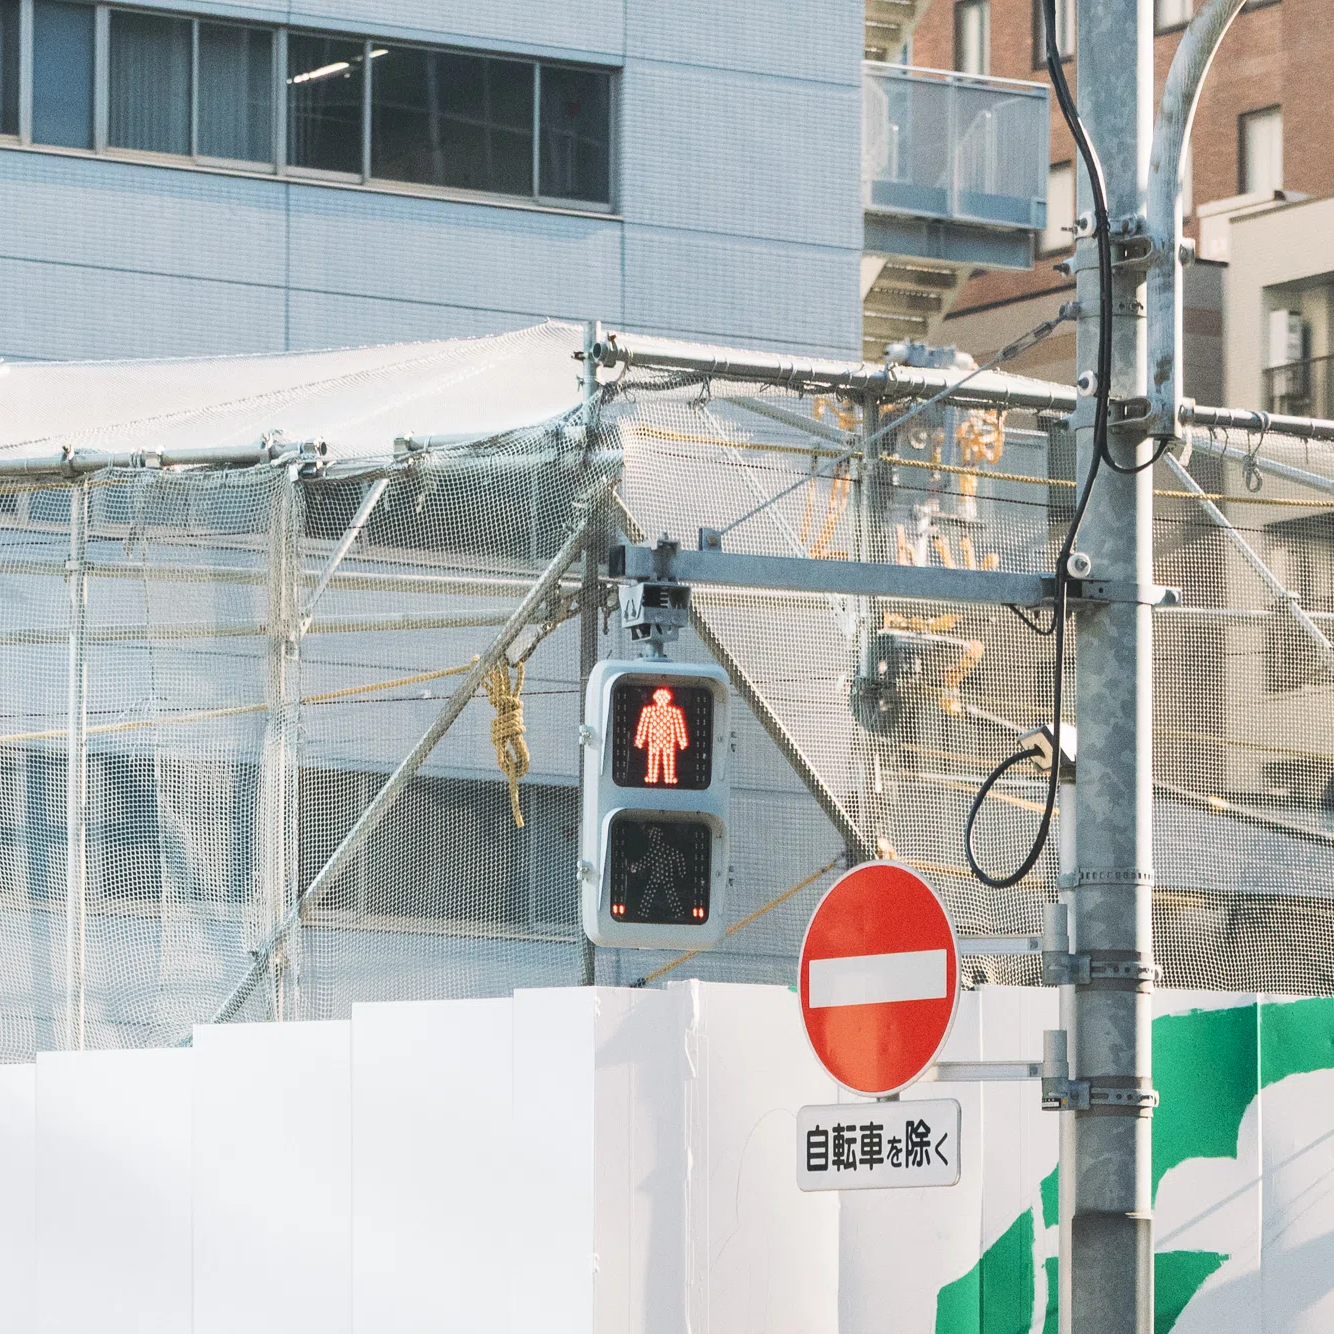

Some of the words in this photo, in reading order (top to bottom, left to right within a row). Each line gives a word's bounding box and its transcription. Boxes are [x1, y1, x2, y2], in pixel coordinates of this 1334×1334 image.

[806, 1118, 949, 1172] 自転車を除く
